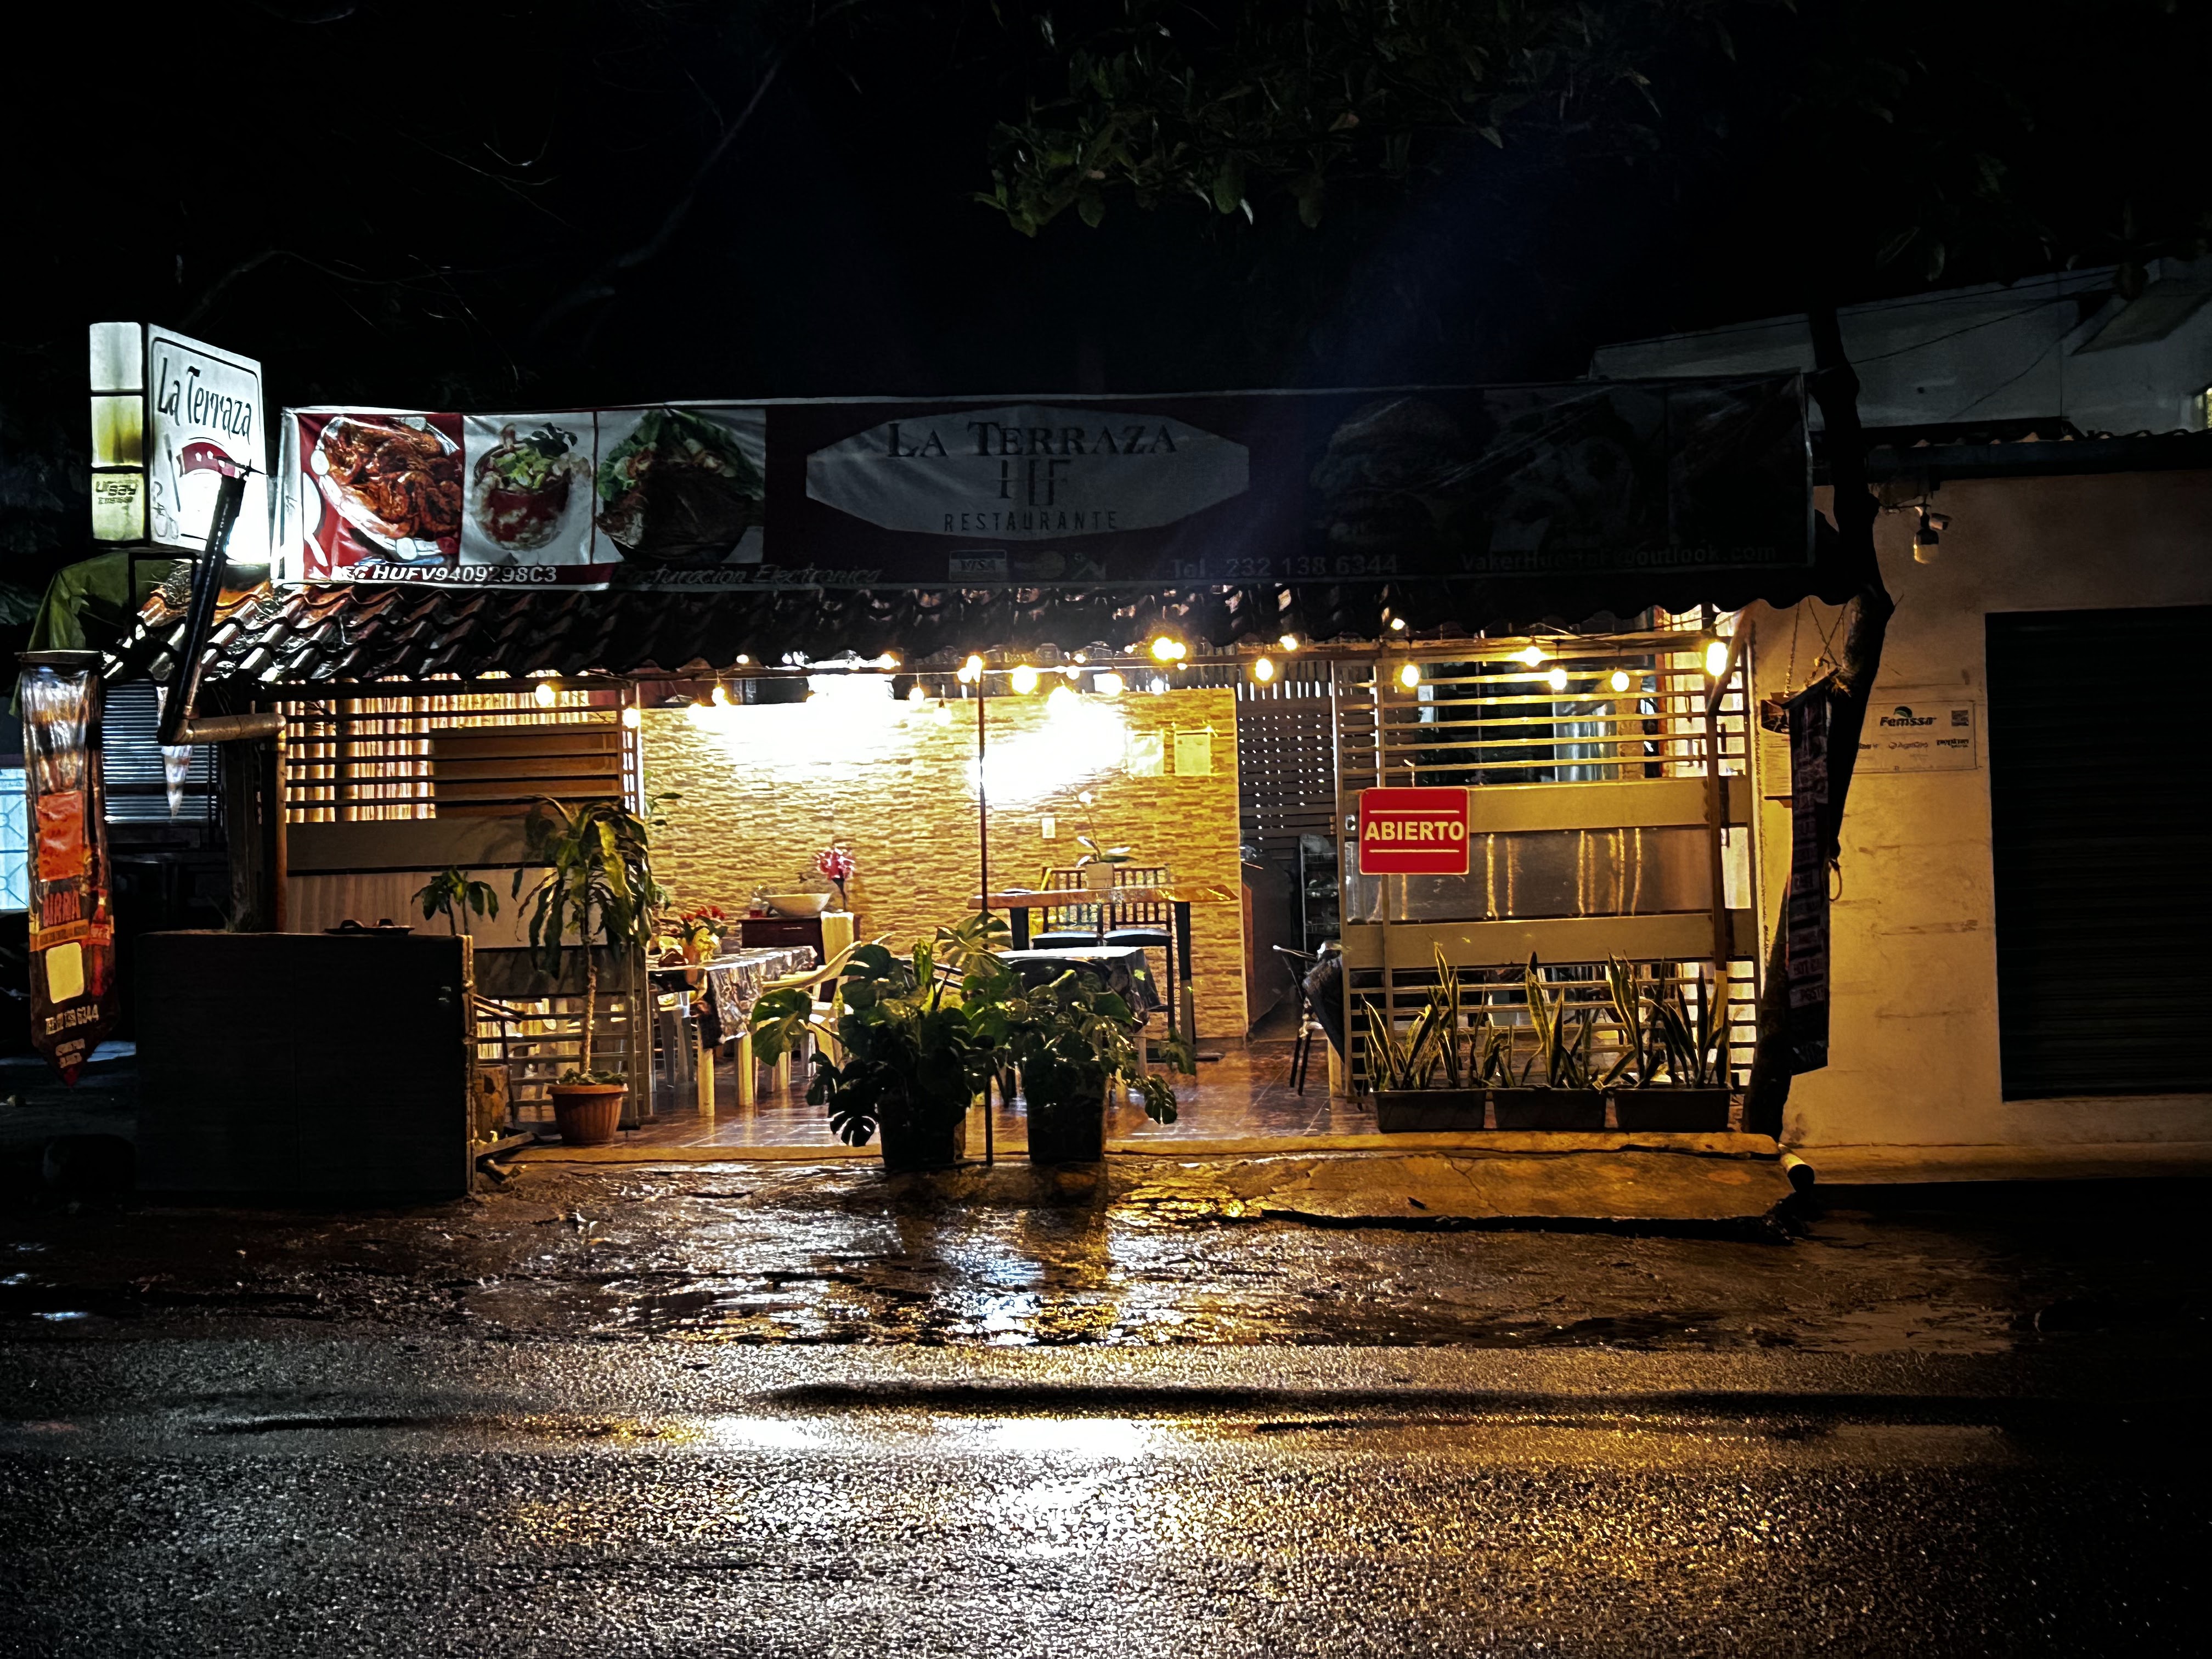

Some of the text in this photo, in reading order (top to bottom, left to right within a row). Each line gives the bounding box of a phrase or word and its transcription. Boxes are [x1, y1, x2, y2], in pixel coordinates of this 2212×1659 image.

[157, 357, 251, 445] La Terraza
[968, 421, 1178, 456] TERRAZA
[945, 511, 1118, 533] RESTAURANTE
[1225, 558, 1272, 578] 232
[1282, 556, 1327, 576] 138
[1335, 554, 1398, 576] 6344
[1364, 821, 1465, 841] ABIERTO
